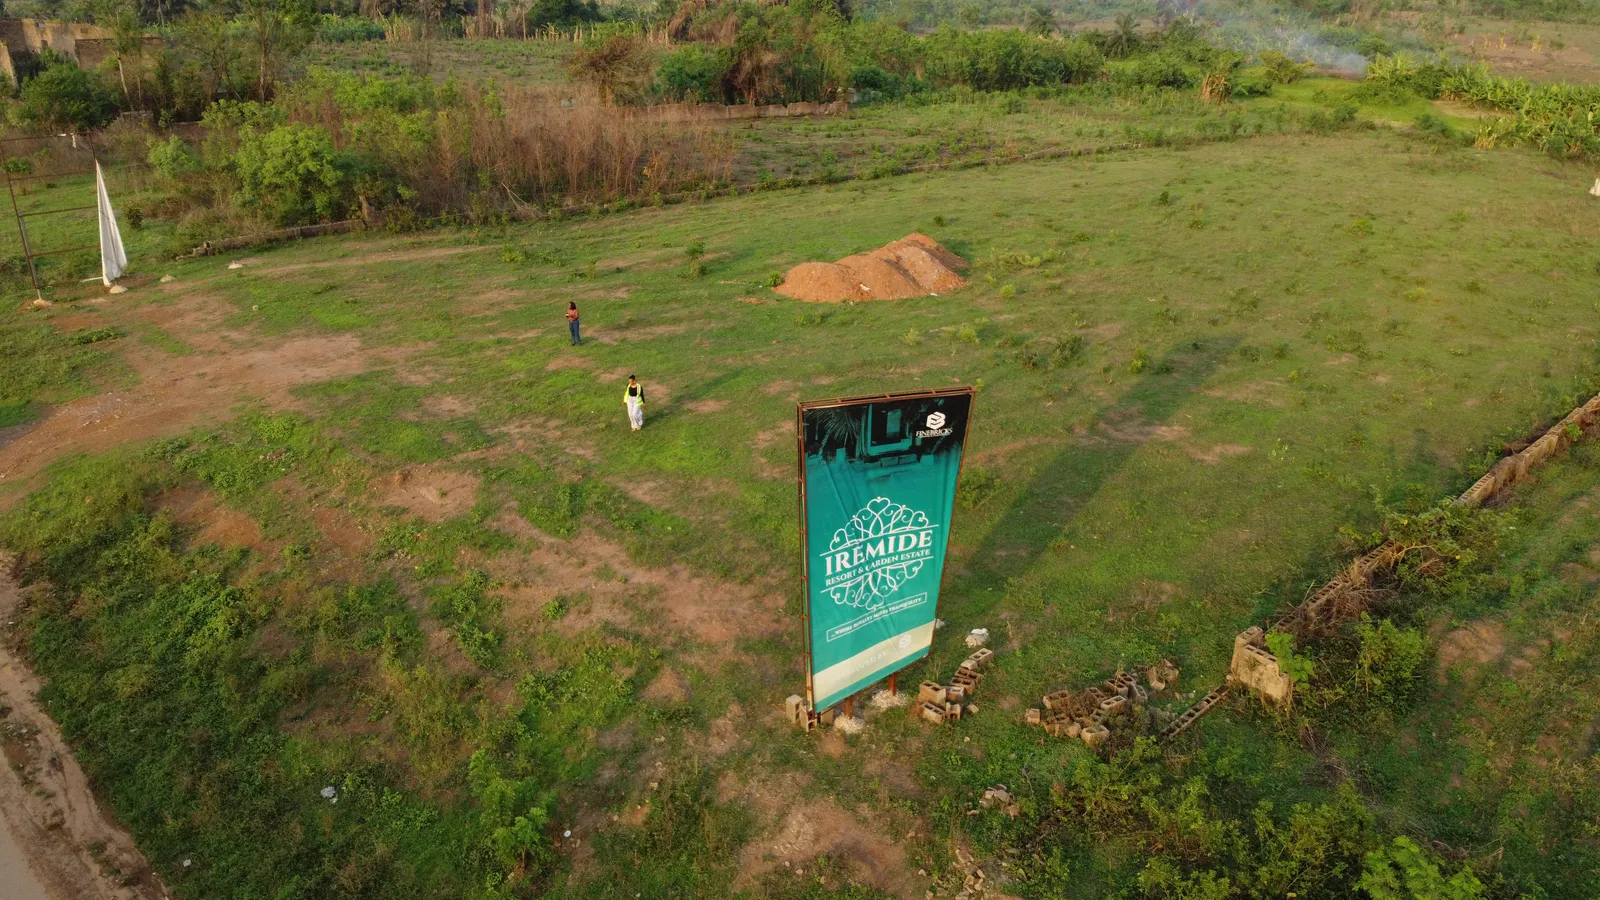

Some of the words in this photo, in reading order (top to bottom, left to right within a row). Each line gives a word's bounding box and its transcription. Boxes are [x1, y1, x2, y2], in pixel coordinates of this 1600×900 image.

[825, 530, 933, 576] IREMIDE
[826, 570, 857, 586] RESORT
[865, 555, 898, 571] GARDEN
[901, 549, 930, 560] ESTATE
